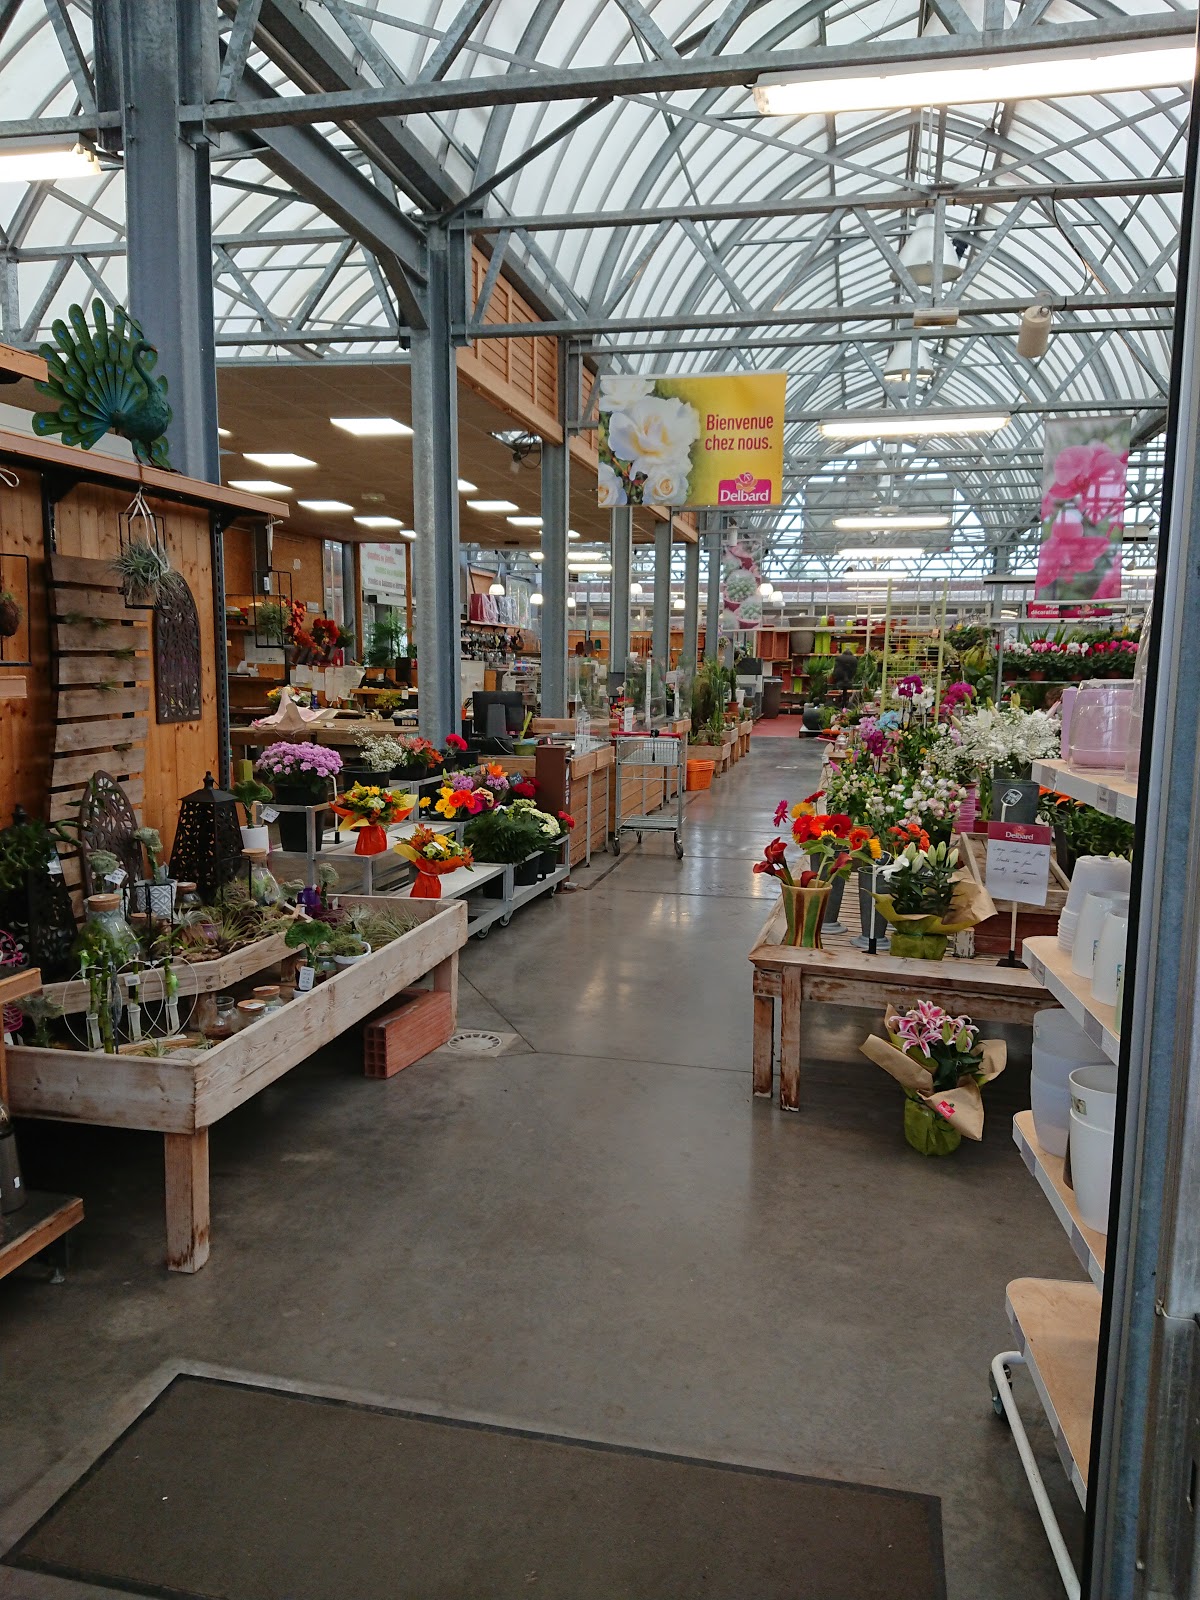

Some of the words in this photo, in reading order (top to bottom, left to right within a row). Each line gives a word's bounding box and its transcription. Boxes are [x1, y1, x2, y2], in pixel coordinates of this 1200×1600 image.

[706, 413, 774, 431] Bienvenue
[705, 434, 735, 451] chez
[737, 436, 773, 450] nous.
[720, 489, 769, 502] Delbard
[1006, 832, 1034, 840] Delbard
